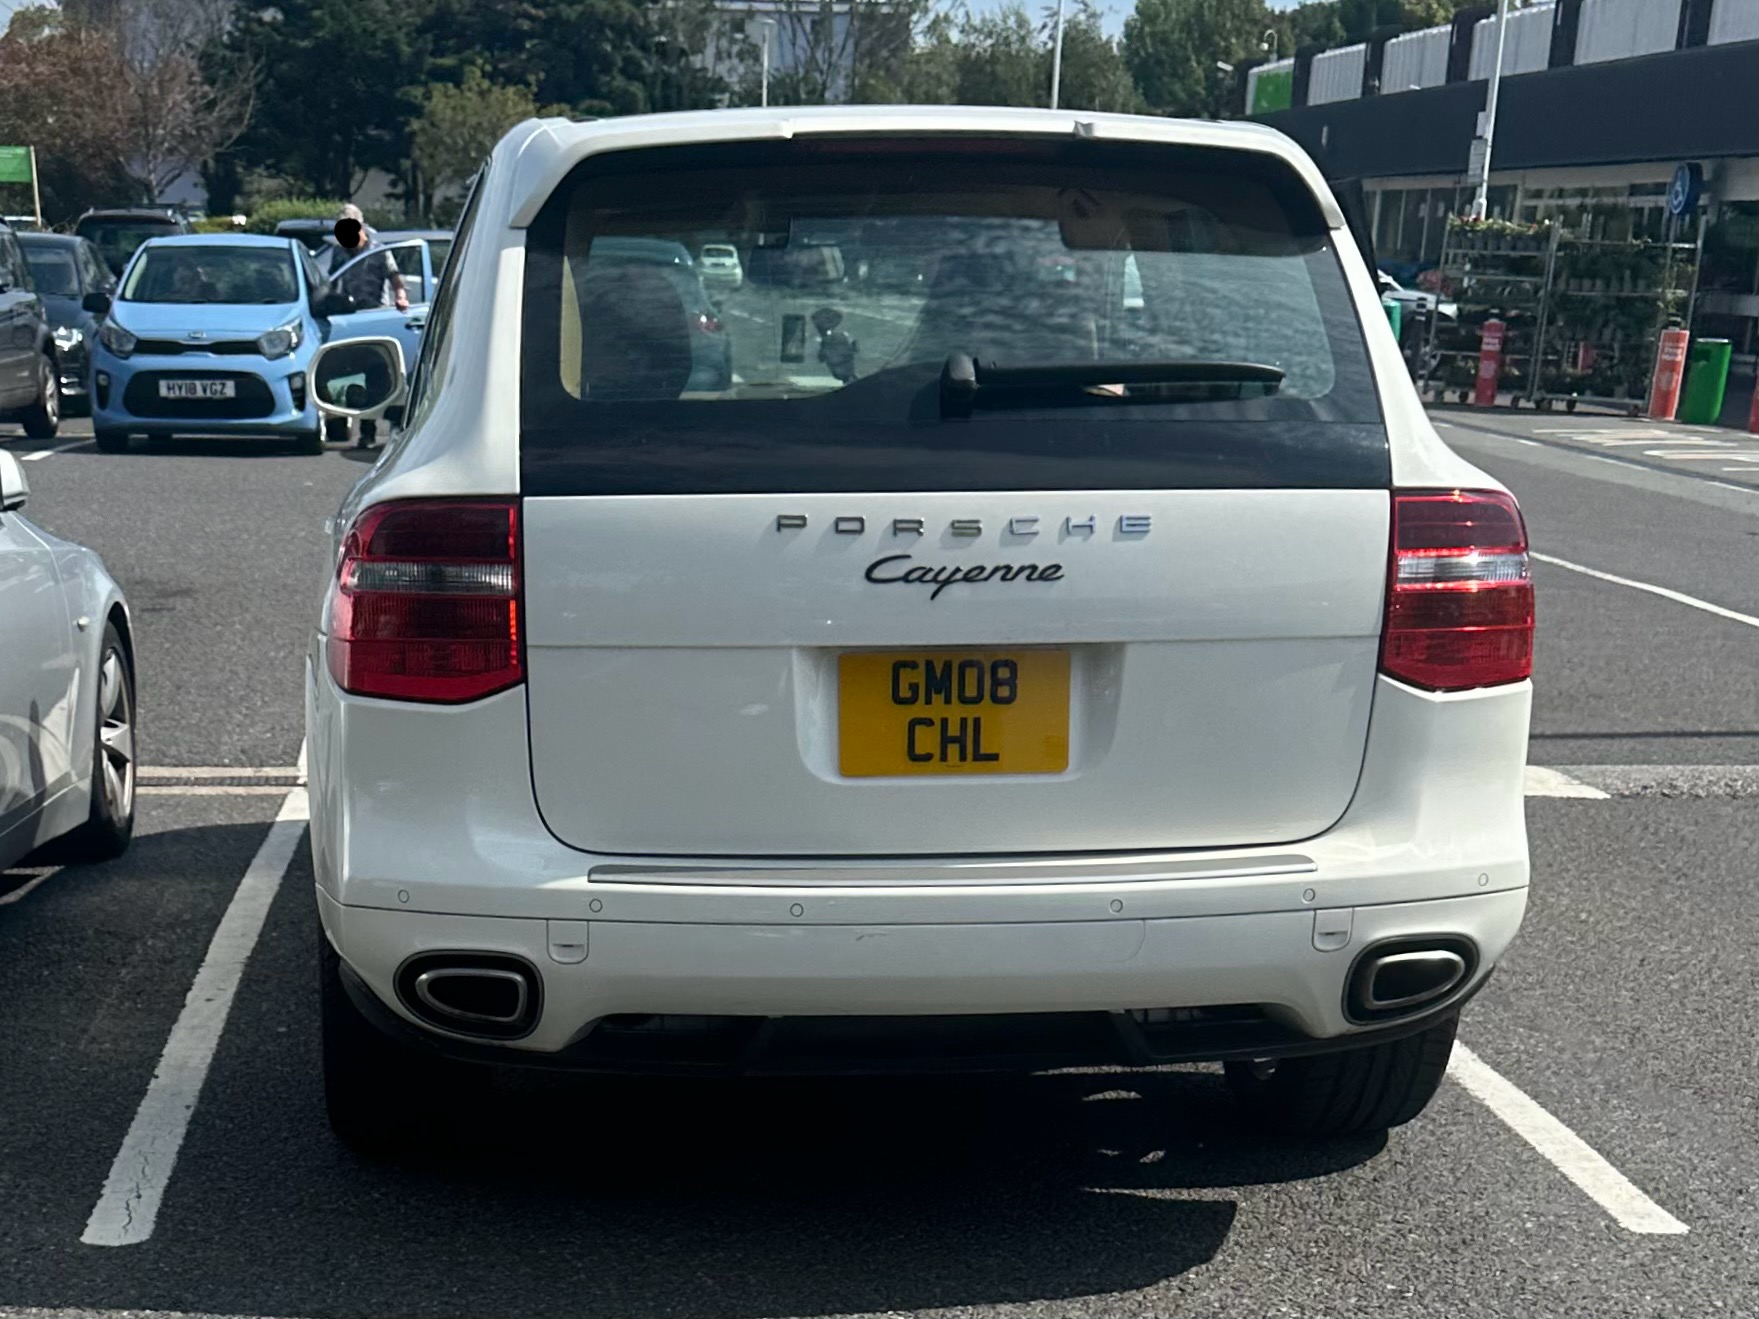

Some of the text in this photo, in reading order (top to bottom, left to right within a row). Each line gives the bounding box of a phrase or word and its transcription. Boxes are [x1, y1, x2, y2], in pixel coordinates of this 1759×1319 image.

[166, 381, 227, 396] HY18 VGZ
[776, 513, 1152, 537] PORSCHE
[864, 554, 1065, 600] Cayenne
[891, 659, 1018, 706] GM08
[907, 716, 1000, 763] CHL
